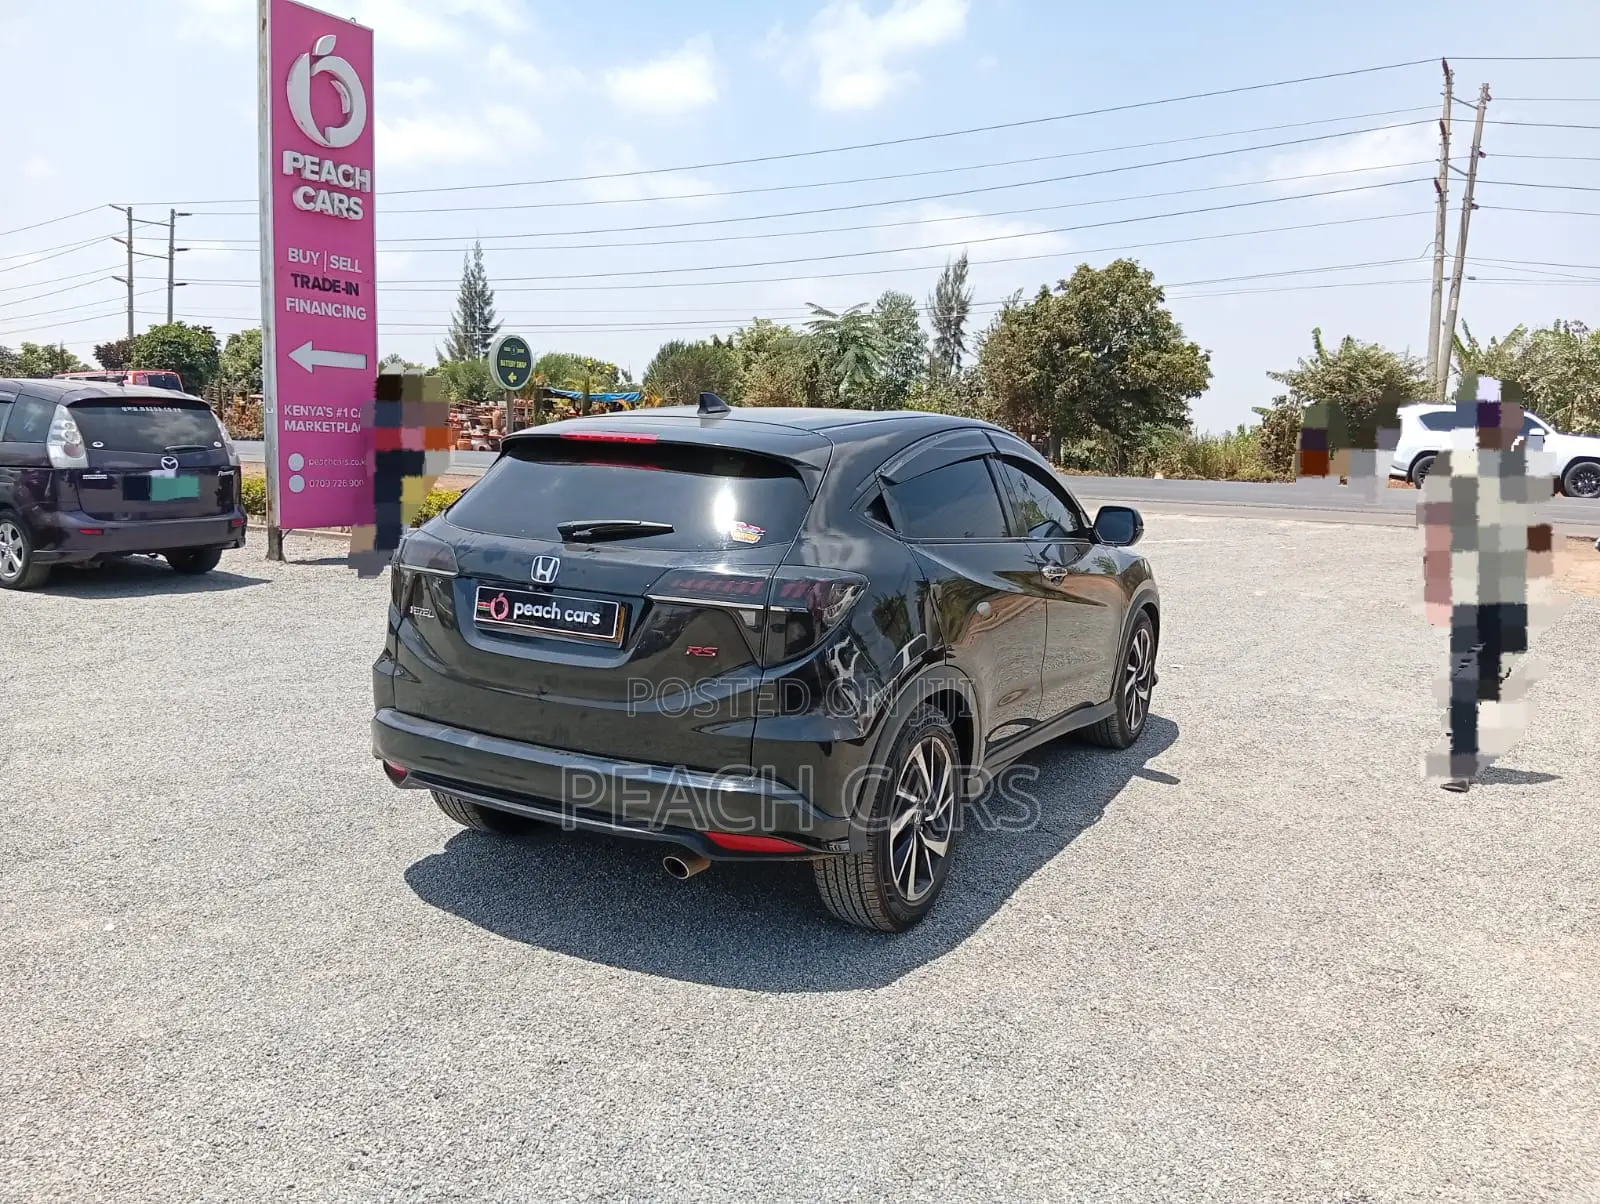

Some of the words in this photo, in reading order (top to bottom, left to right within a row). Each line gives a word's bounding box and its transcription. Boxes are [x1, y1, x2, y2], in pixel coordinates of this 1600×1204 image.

[282, 150, 371, 192] PEACH
[292, 185, 364, 221] CARS
[288, 248, 320, 266] BUY
[330, 255, 362, 273] SELL
[291, 272, 360, 296] TRADE-IN
[286, 297, 367, 320] FINANCING
[284, 404, 333, 418] KENYA'S
[336, 407, 348, 418] #1
[350, 407, 360, 418] C
[513, 601, 561, 620] peach
[564, 608, 601, 625] cars
[686, 645, 719, 657] RS
